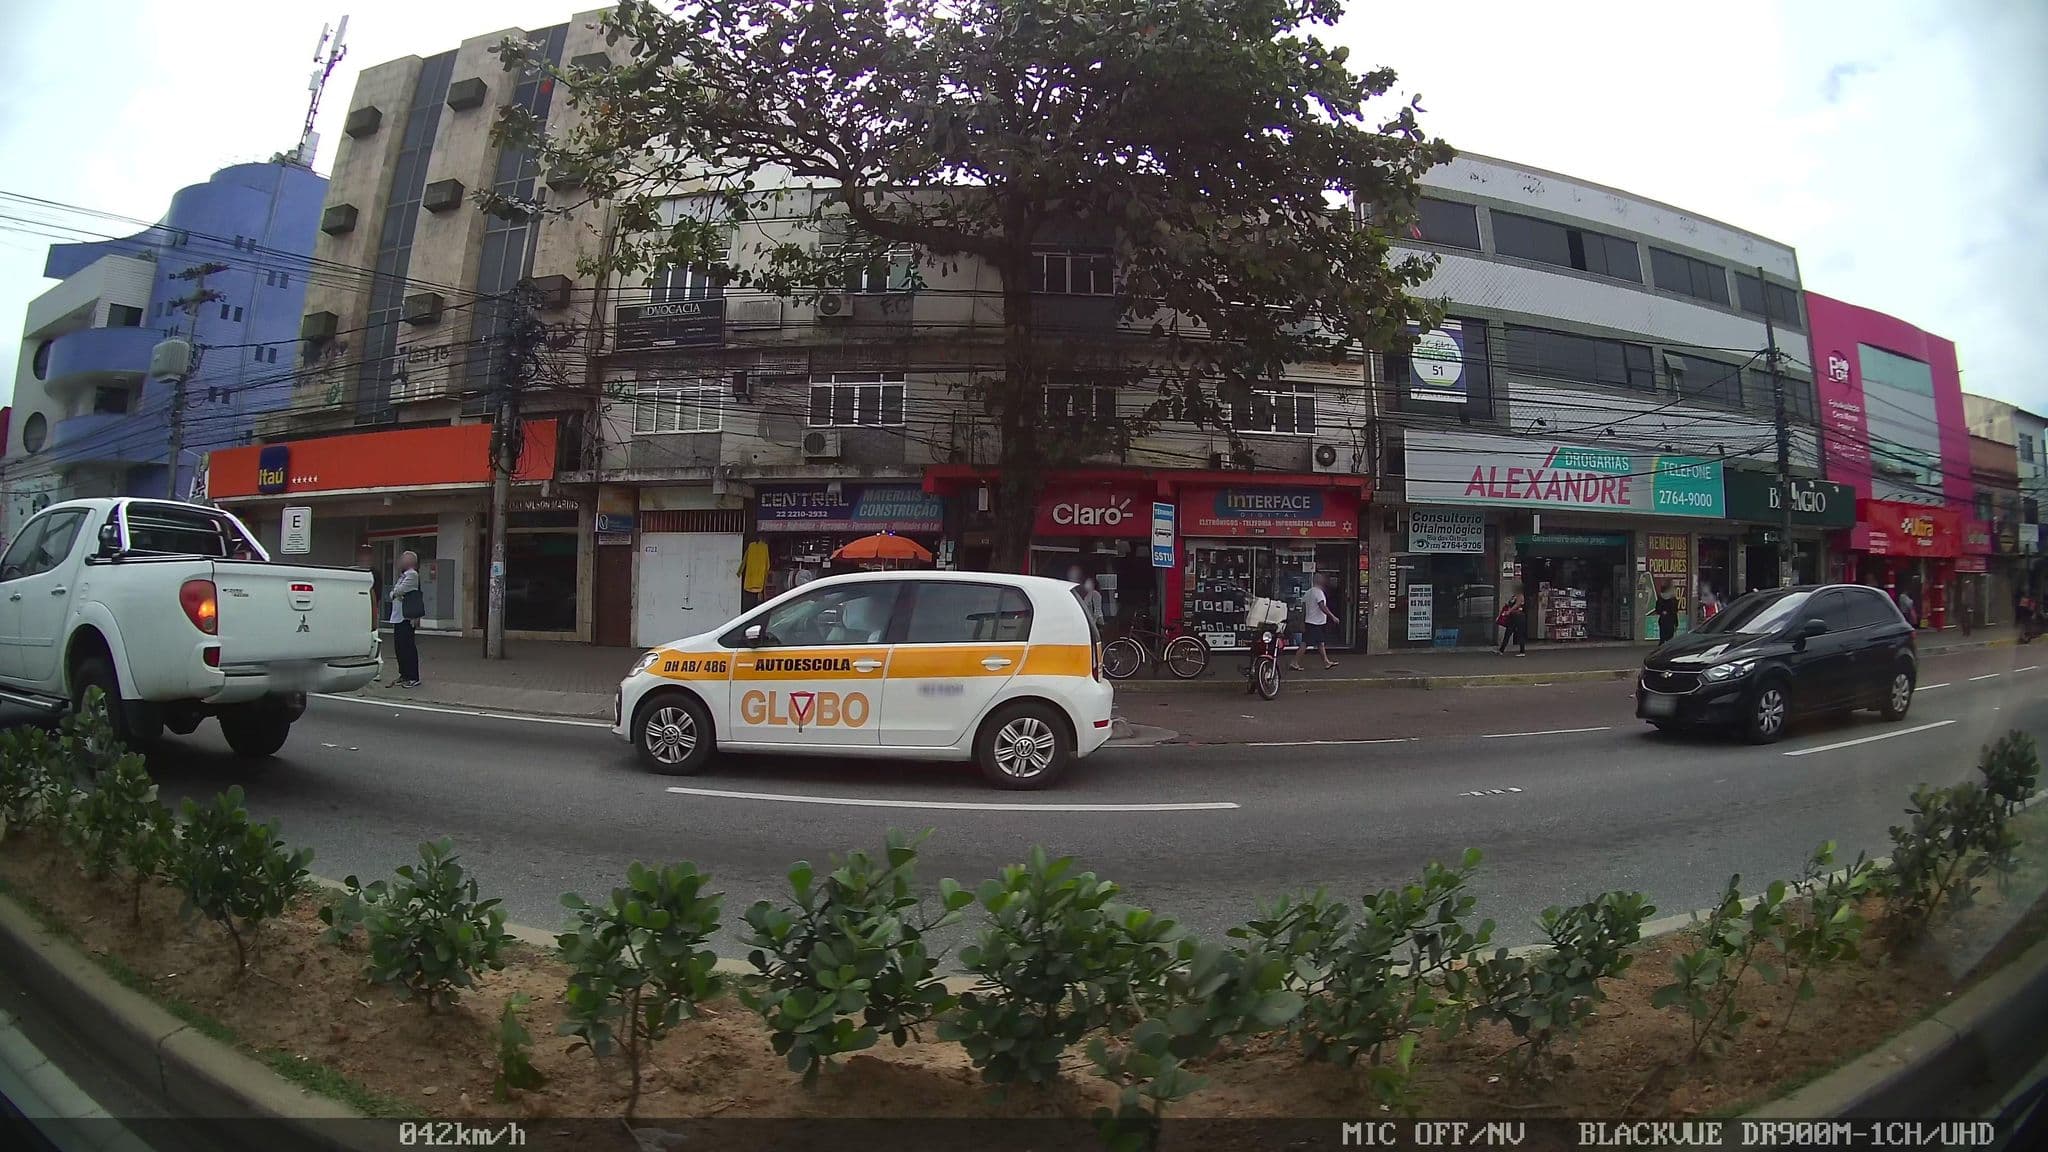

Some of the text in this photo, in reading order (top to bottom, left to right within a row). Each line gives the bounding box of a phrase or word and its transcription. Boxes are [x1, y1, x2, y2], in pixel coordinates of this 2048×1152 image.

[1432, 365, 1443, 376] 51
[1564, 452, 1629, 471] DROGARIAS
[258, 467, 284, 485] Itaú
[1661, 460, 1712, 480] TELEFONE
[1464, 465, 1631, 505] ALEXANDRE
[761, 492, 849, 507] CENTRAL
[863, 489, 922, 502] MATERIAIS
[1659, 490, 1713, 508] 2764-9000
[859, 502, 938, 518] CONSTRUÇÃO
[1053, 503, 1122, 525] Claro
[292, 515, 302, 528] E
[1154, 551, 1172, 562] SSTU
[1649, 559, 1687, 573] POPULARES
[663, 660, 727, 673] DH AB/ 486
[755, 658, 851, 672] AUTOESCOLA
[741, 689, 870, 728] GLOBO
